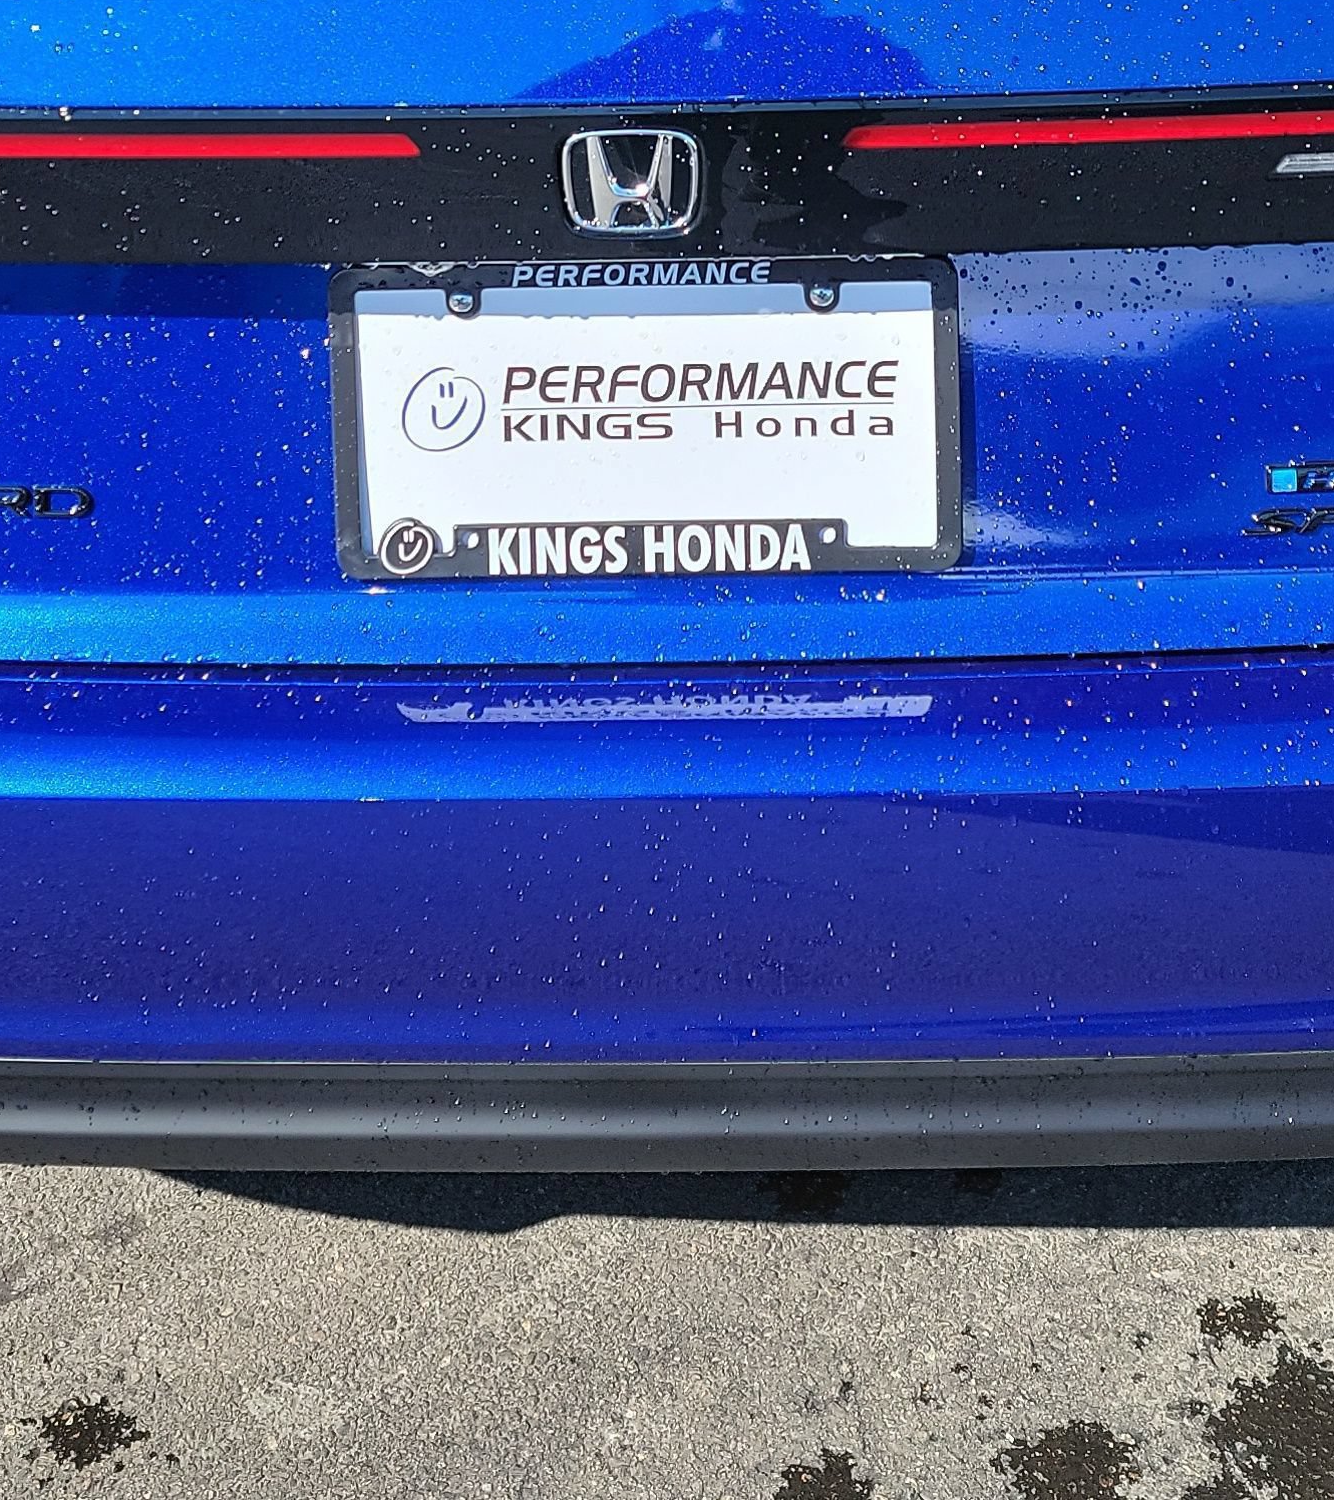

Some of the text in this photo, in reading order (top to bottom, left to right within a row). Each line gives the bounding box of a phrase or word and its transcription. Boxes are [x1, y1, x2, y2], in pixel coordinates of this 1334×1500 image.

[511, 262, 771, 288] PERFORMANCE
[502, 360, 900, 405] PERFORMANCE
[502, 409, 895, 443] KINGS Honda
[487, 524, 812, 576] KINGS HONDA
